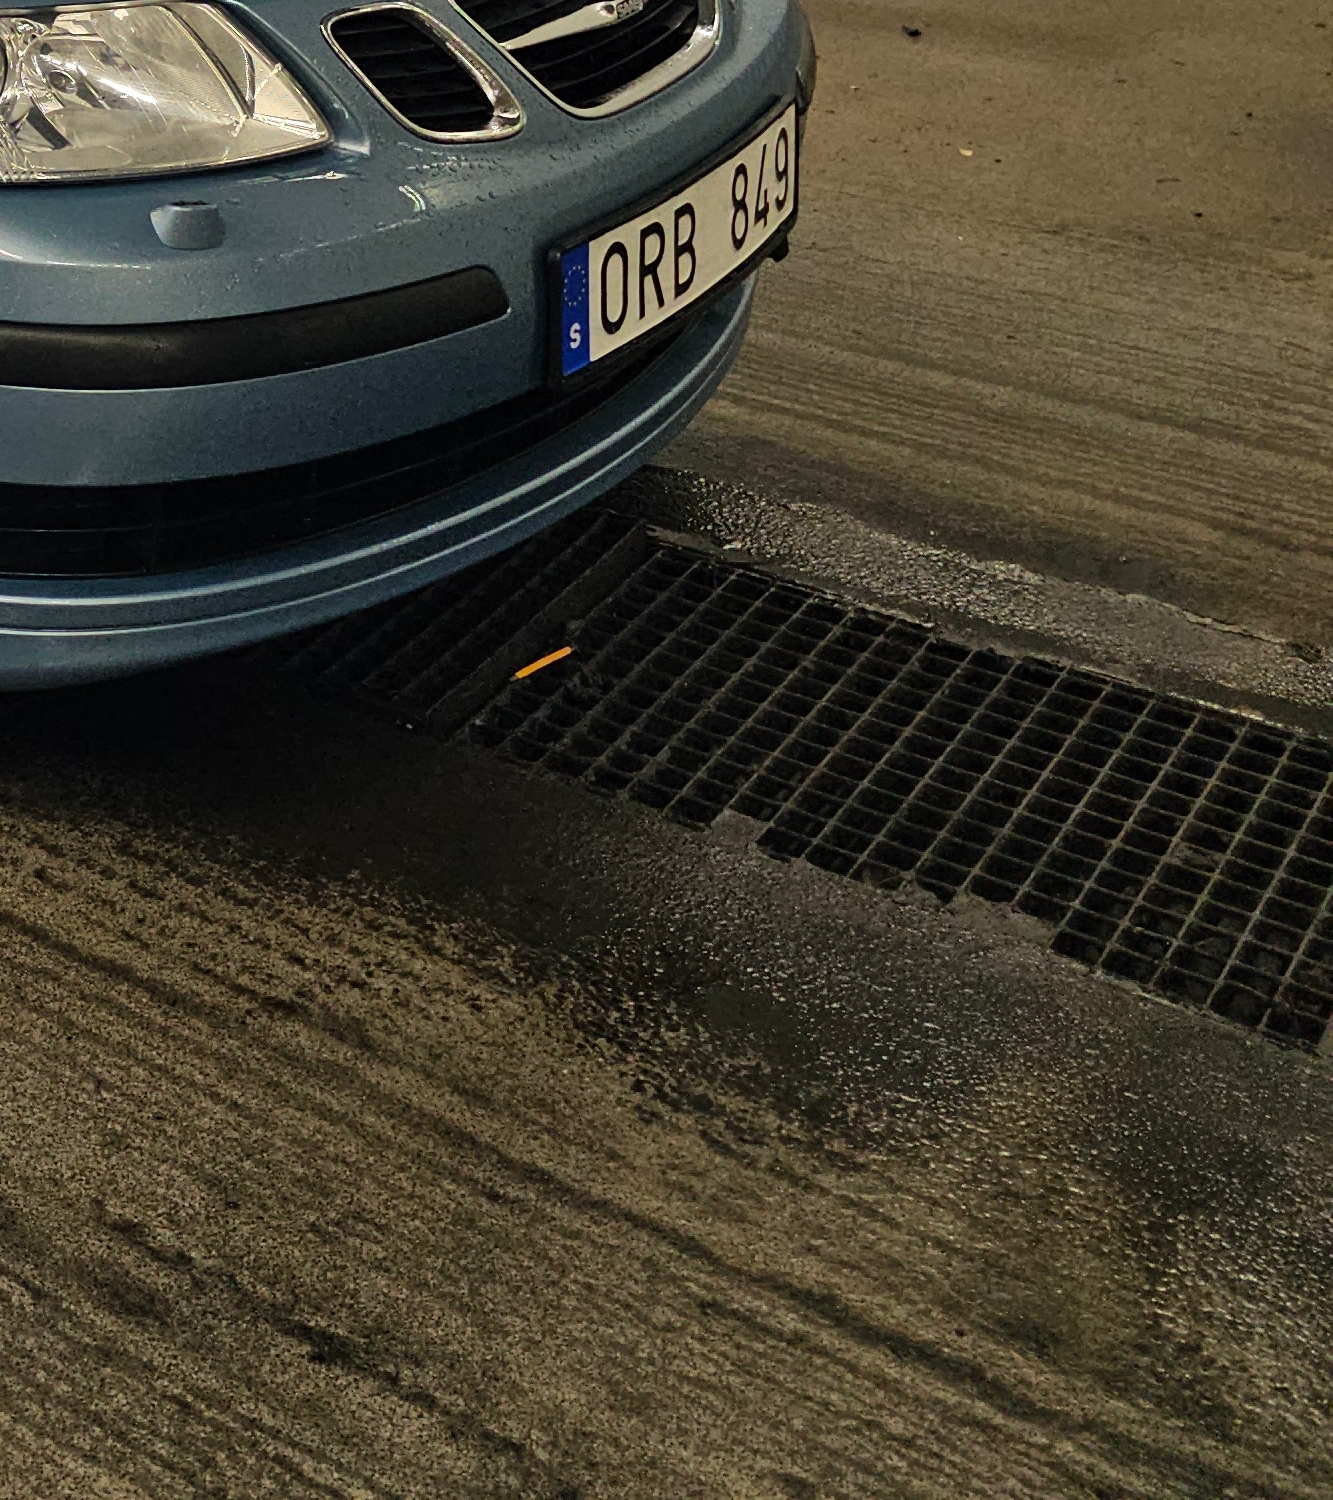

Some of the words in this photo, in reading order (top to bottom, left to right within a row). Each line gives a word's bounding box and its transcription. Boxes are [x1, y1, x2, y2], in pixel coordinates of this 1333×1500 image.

[600, 202, 697, 335] ORB
[730, 127, 789, 252] 849
[570, 322, 581, 349] S
